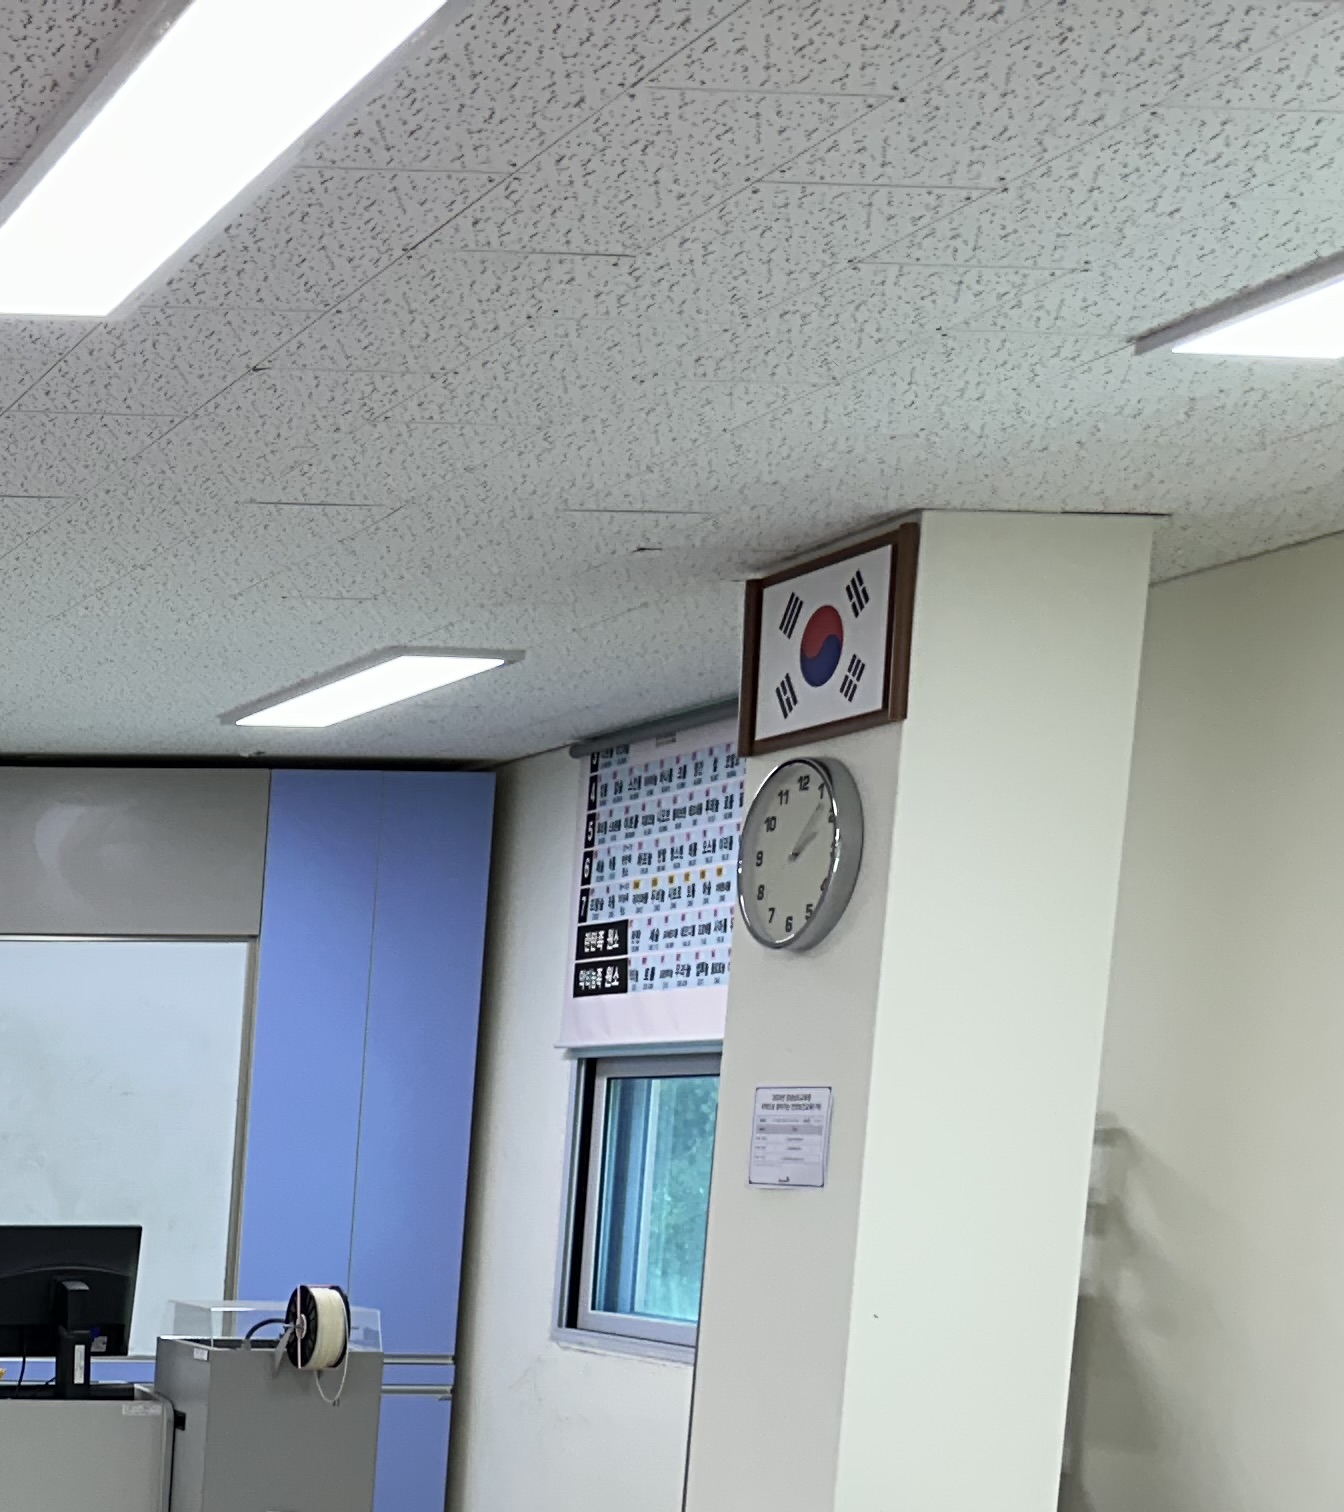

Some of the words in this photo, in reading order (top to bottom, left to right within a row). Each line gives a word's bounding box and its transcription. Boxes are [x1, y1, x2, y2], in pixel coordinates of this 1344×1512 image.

[797, 775, 810, 791] 12
[818, 783, 825, 799] 1
[778, 790, 790, 805] 11
[764, 816, 776, 832] 10
[587, 823, 593, 843] 5
[755, 851, 763, 866] 9
[583, 858, 589, 877] 6
[757, 885, 764, 900] 8
[768, 908, 776, 923] 7
[805, 904, 813, 920] 5
[785, 916, 793, 932] 6
